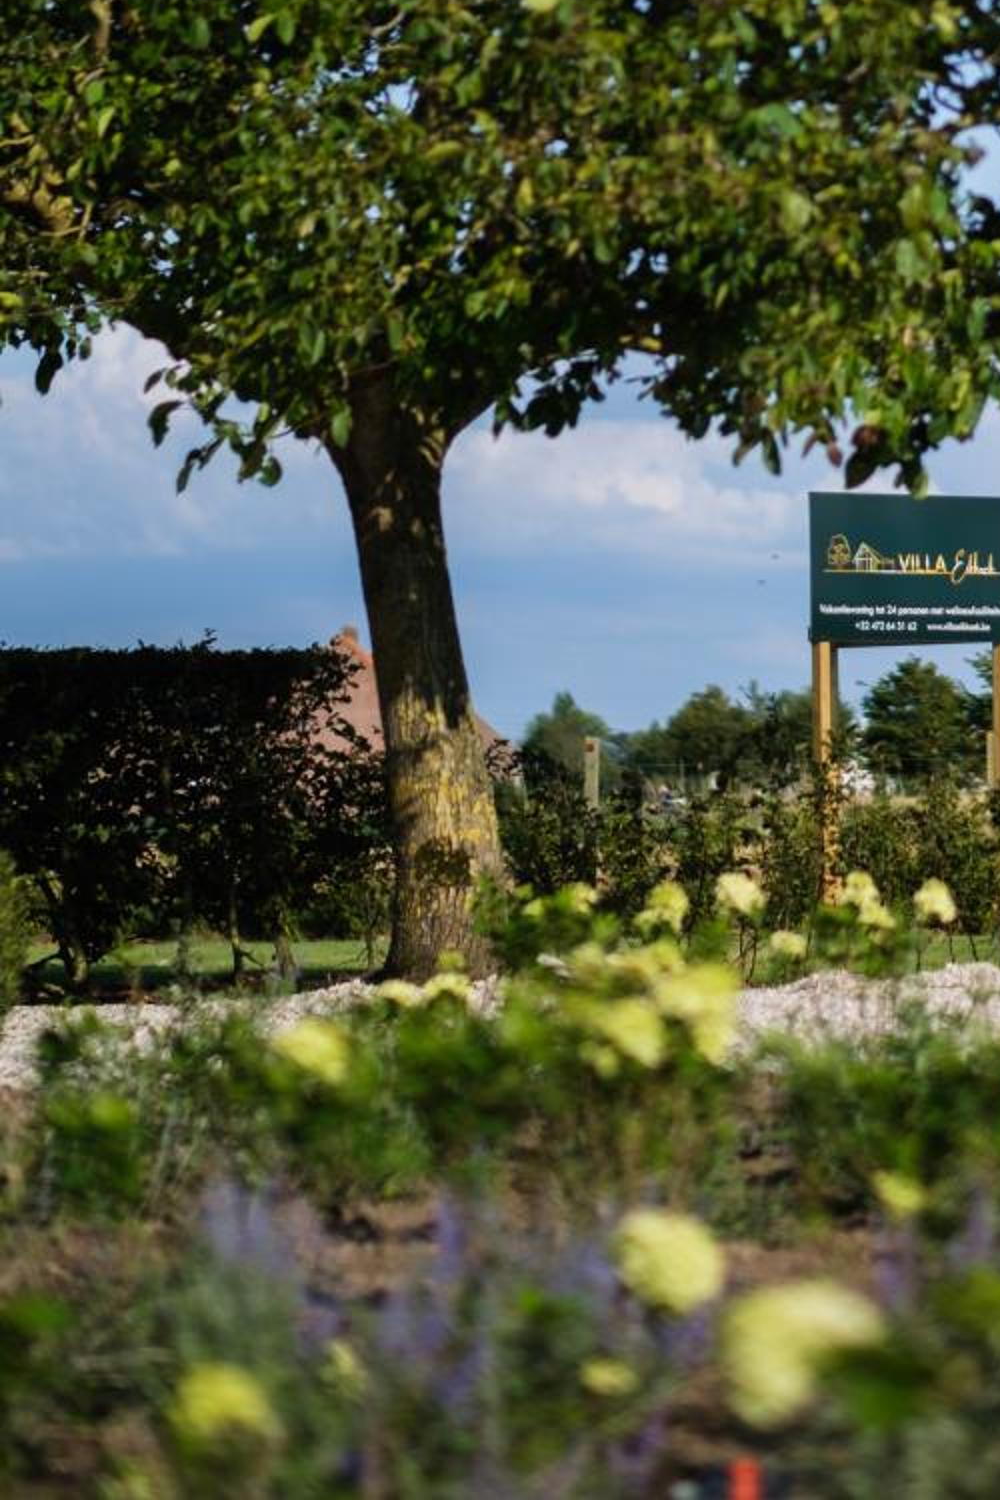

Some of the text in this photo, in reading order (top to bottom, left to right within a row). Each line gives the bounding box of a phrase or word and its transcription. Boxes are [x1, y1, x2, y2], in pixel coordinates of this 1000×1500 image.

[897, 553, 947, 573] VILLA
[887, 604, 897, 615] 24
[855, 620, 870, 631] +32
